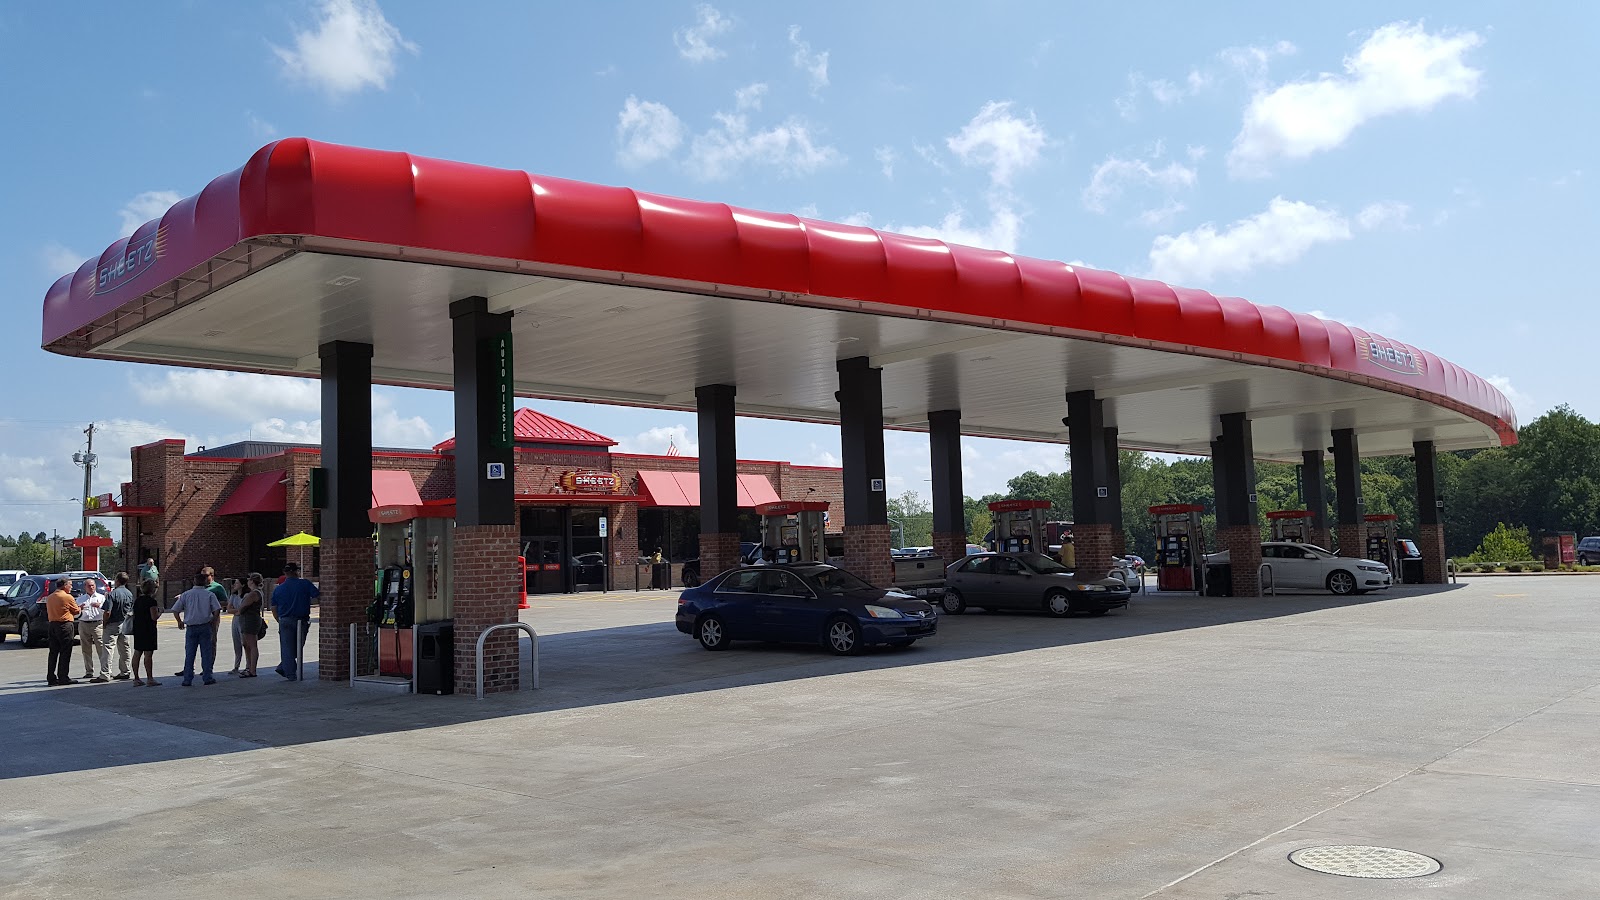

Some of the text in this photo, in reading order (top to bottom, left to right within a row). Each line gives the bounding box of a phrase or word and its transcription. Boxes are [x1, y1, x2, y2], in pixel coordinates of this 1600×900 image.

[99, 239, 154, 288] SHEETZ
[1369, 342, 1415, 369] SHEETZ
[575, 475, 615, 485] SHEETZ
